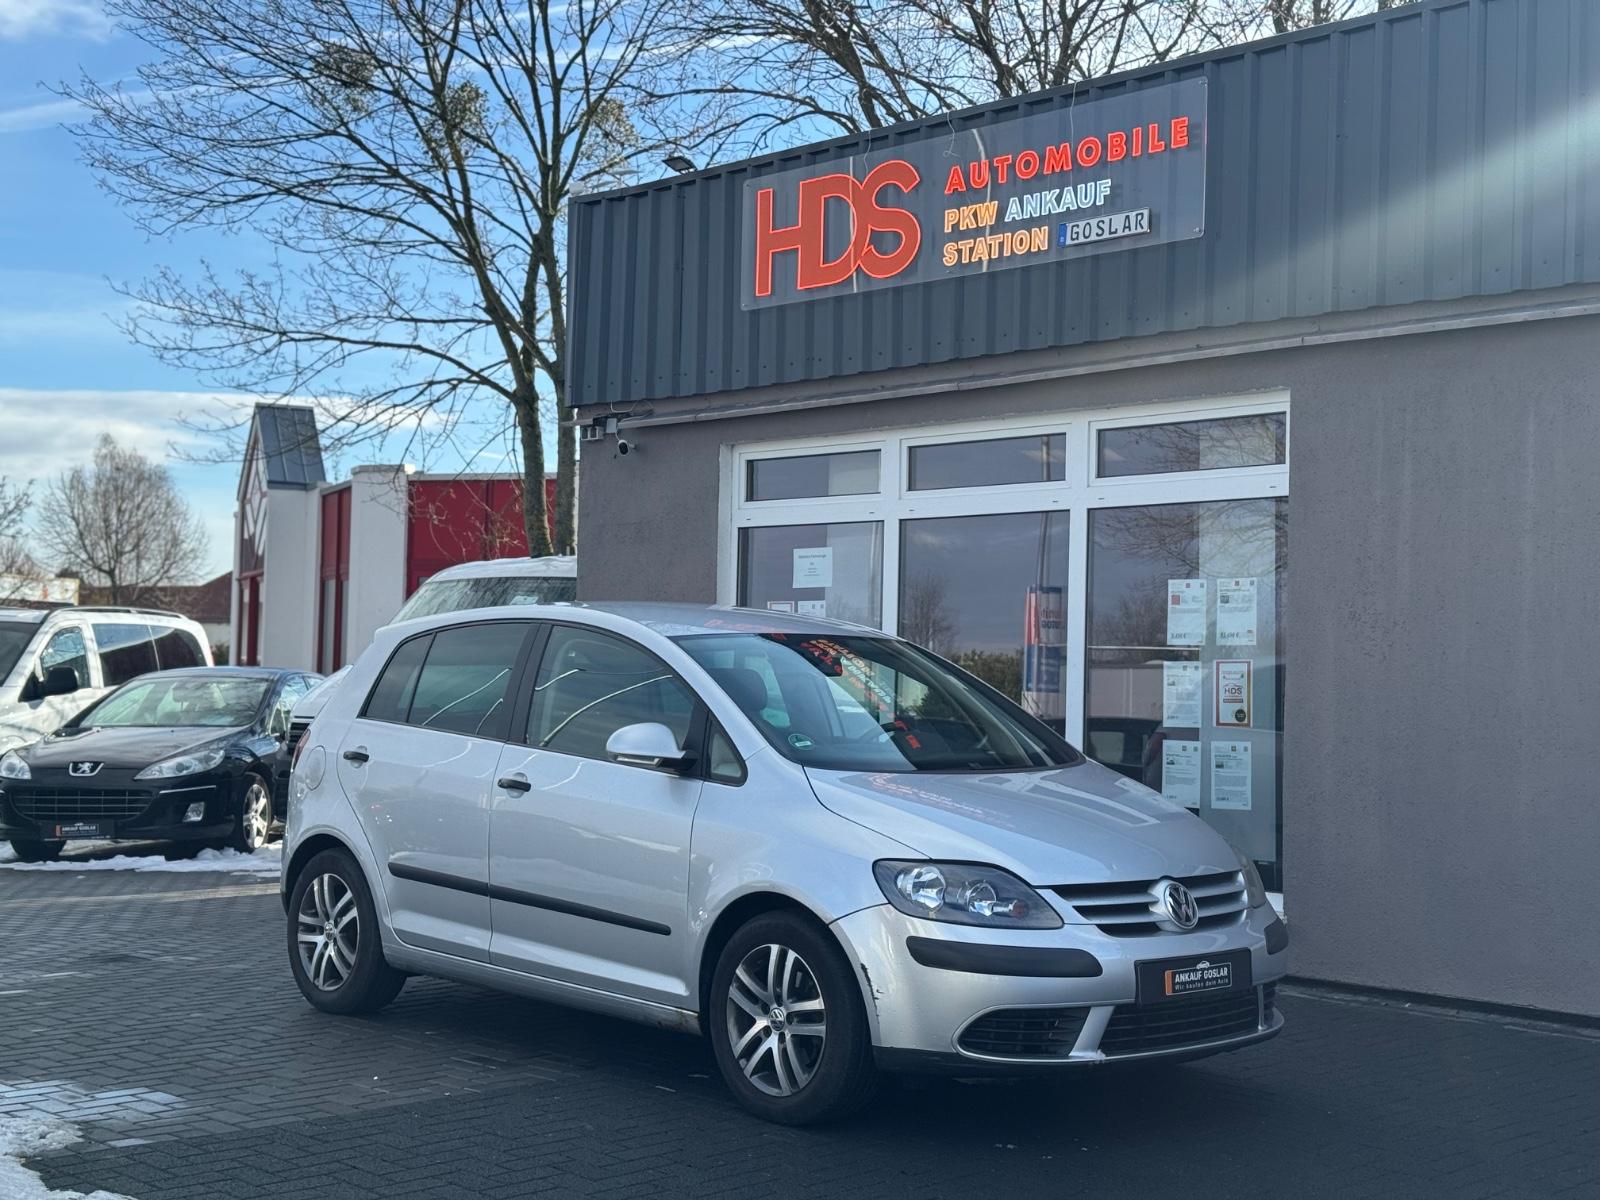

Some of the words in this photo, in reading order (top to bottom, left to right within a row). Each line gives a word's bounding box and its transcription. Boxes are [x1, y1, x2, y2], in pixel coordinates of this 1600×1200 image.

[944, 116, 1190, 195] AUTOMOBILE
[755, 159, 922, 297] HDS
[943, 200, 998, 233] PKW
[1004, 178, 1112, 223] ANKAUF
[941, 225, 1049, 267] STATION
[1070, 212, 1144, 242] GOSLAR
[1224, 687, 1242, 696] HDS
[1174, 971, 1202, 983] ANKAUF
[1203, 966, 1228, 980] GOSLAR
